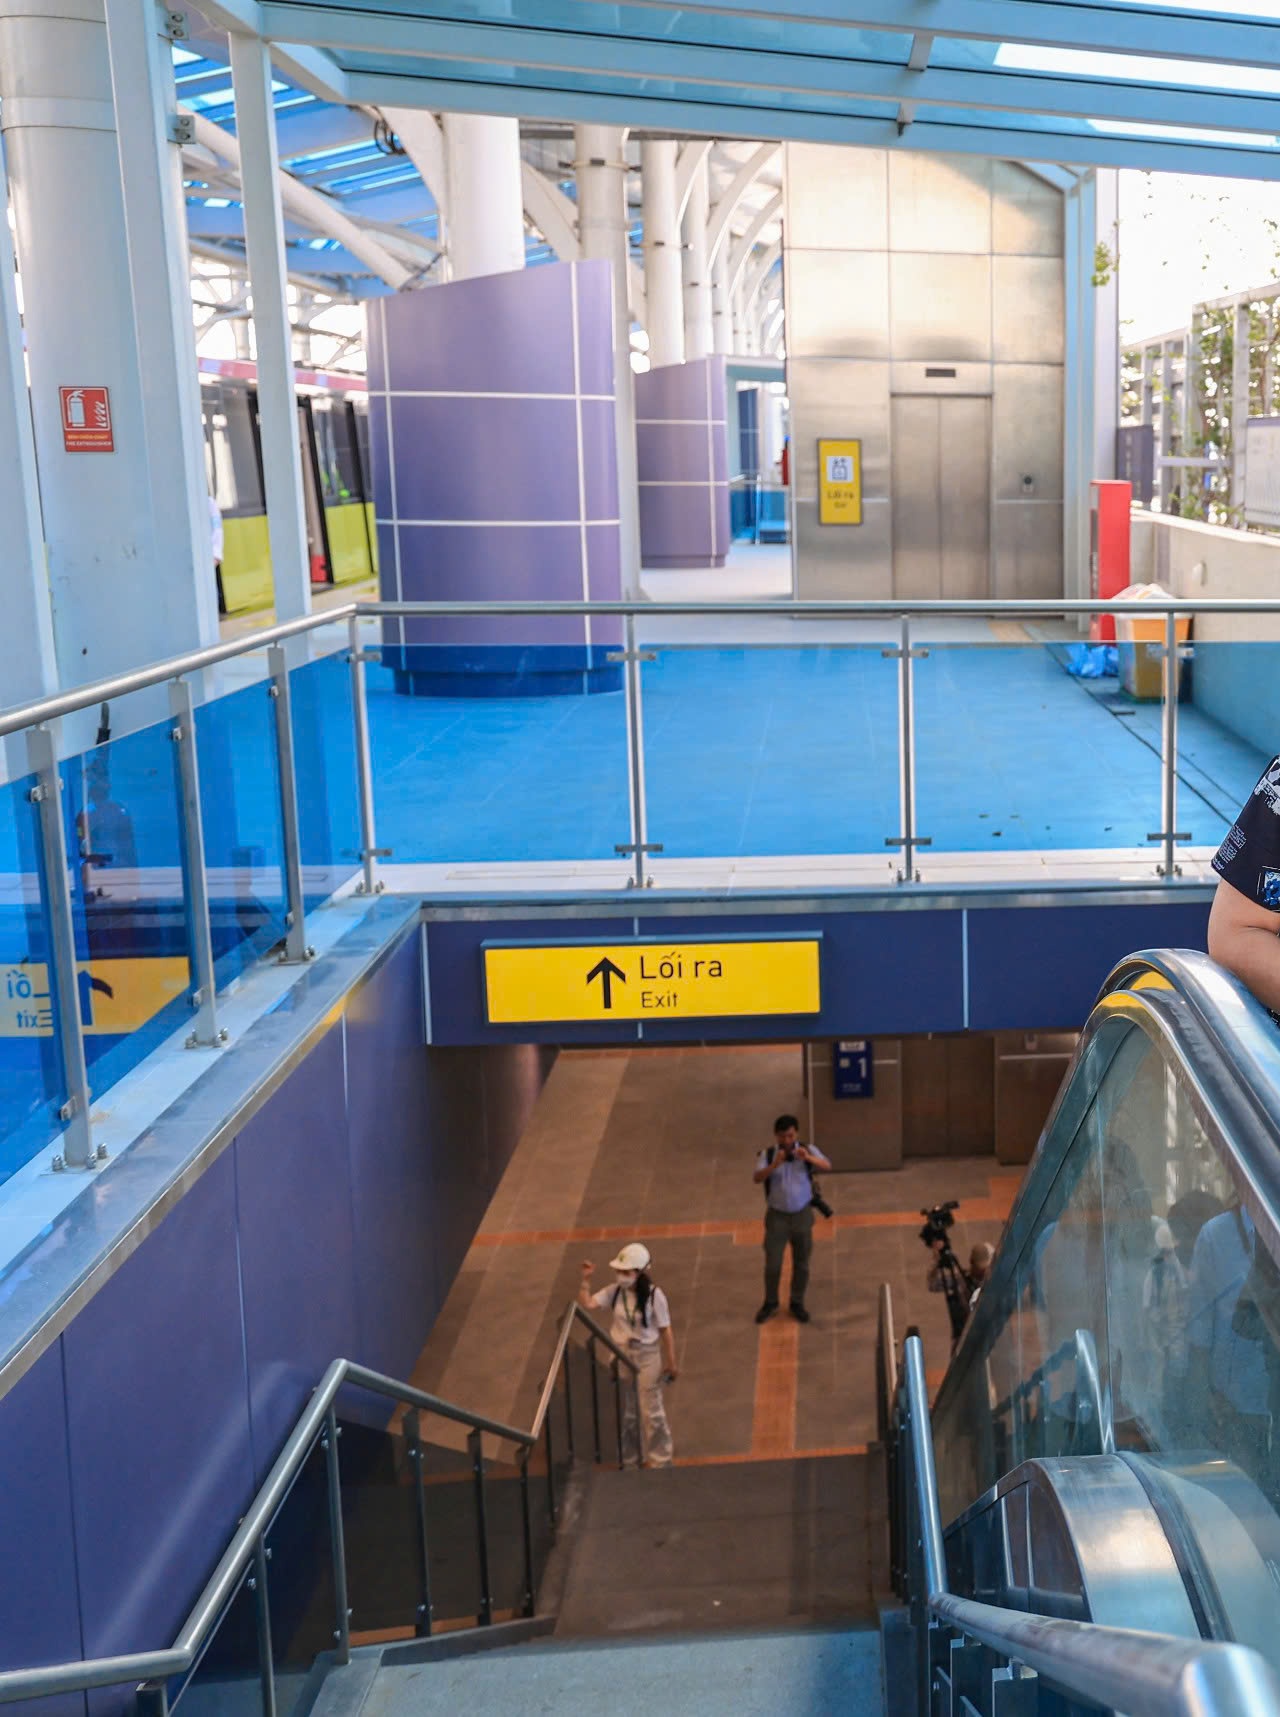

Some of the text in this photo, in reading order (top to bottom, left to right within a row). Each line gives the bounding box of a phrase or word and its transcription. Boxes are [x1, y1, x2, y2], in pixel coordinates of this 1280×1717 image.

[640, 951, 723, 980] Lối ra
[641, 991, 678, 1008] Exit
[858, 1058, 866, 1078] 1
